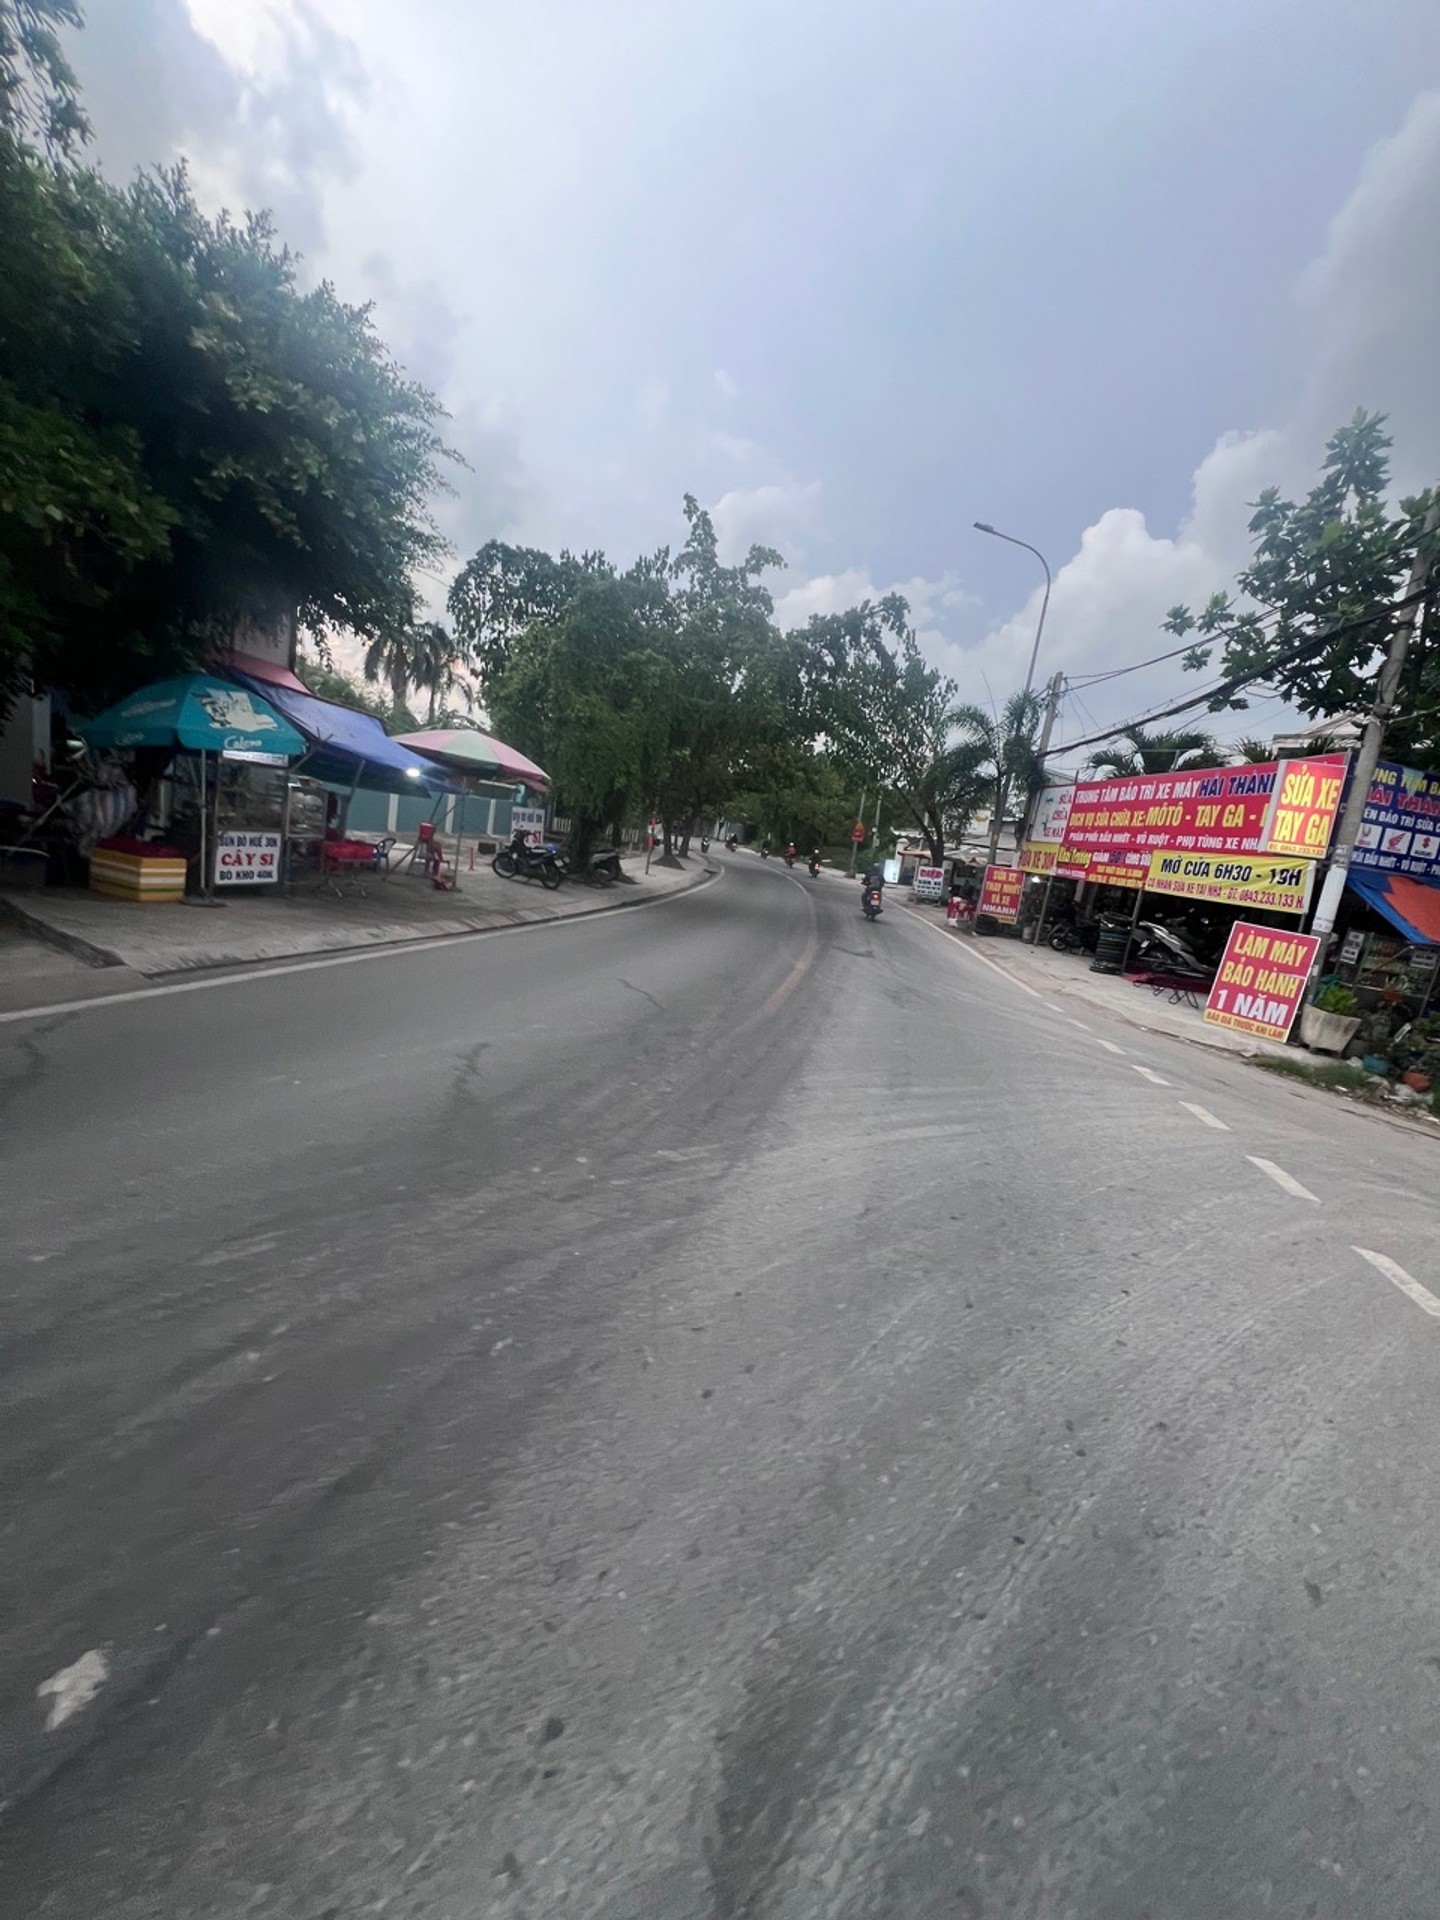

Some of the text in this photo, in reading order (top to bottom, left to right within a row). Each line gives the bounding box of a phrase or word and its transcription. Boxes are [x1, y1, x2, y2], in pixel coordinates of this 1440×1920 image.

[1075, 789, 1100, 804] TRUNG
[1100, 785, 1119, 803] TÂM
[1119, 781, 1138, 802] BẢO
[1139, 781, 1156, 800] TRÌ
[1155, 782, 1173, 799] XE
[1172, 778, 1200, 799] MÁY
[1199, 772, 1226, 798] HẢI
[1280, 764, 1341, 810] SỬA XE
[1371, 768, 1397, 785] UNG
[1094, 807, 1110, 827] SỬA
[1110, 808, 1131, 827] CHỮA
[1145, 801, 1184, 828] MÔTÔ
[1195, 804, 1222, 828] TAY
[1222, 804, 1245, 828] GA
[1273, 809, 1330, 846] TAY GA
[1379, 810, 1399, 825] BẢO
[1401, 815, 1416, 828] TRÌ
[1416, 817, 1434, 832] SỬA
[1136, 831, 1147, 844] VỎ
[1147, 833, 1170, 847] RUỘT
[1176, 835, 1196, 849] PHỤ
[1197, 834, 1224, 849] TÙNG
[1224, 837, 1241, 850] XE
[221, 849, 274, 866] CÂY SI
[1160, 855, 1183, 874] MỞ
[1184, 857, 1211, 878] CỬA
[1214, 863, 1253, 883] 6H30
[1269, 868, 1303, 887] 19H
[235, 870, 254, 880] KHO
[1234, 930, 1308, 967] LÀM MÁY
[1221, 956, 1300, 999] BẢO HÀNH
[1216, 988, 1289, 1026] 1 NĂM
